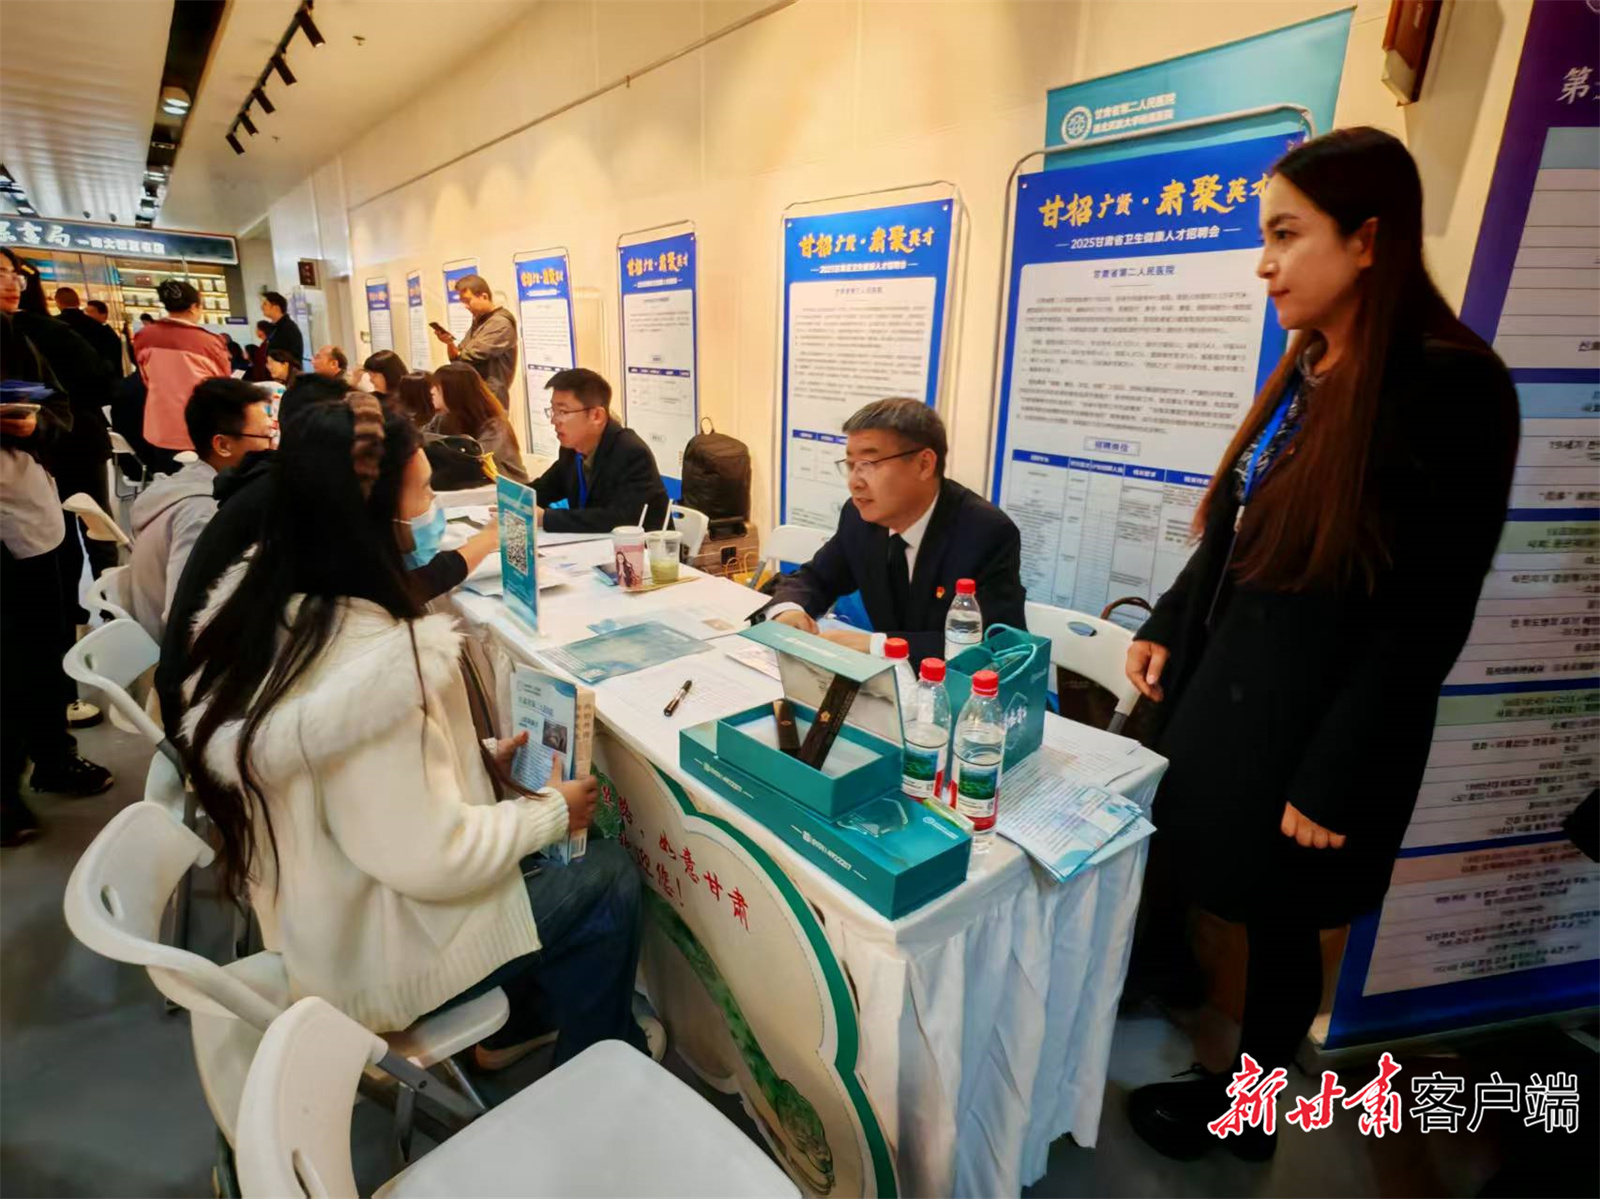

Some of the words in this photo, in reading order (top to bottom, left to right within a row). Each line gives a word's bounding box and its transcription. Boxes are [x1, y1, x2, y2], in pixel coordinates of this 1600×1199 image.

[1071, 226, 1220, 249] 2025甘肃省卫生健康人才招聘会
